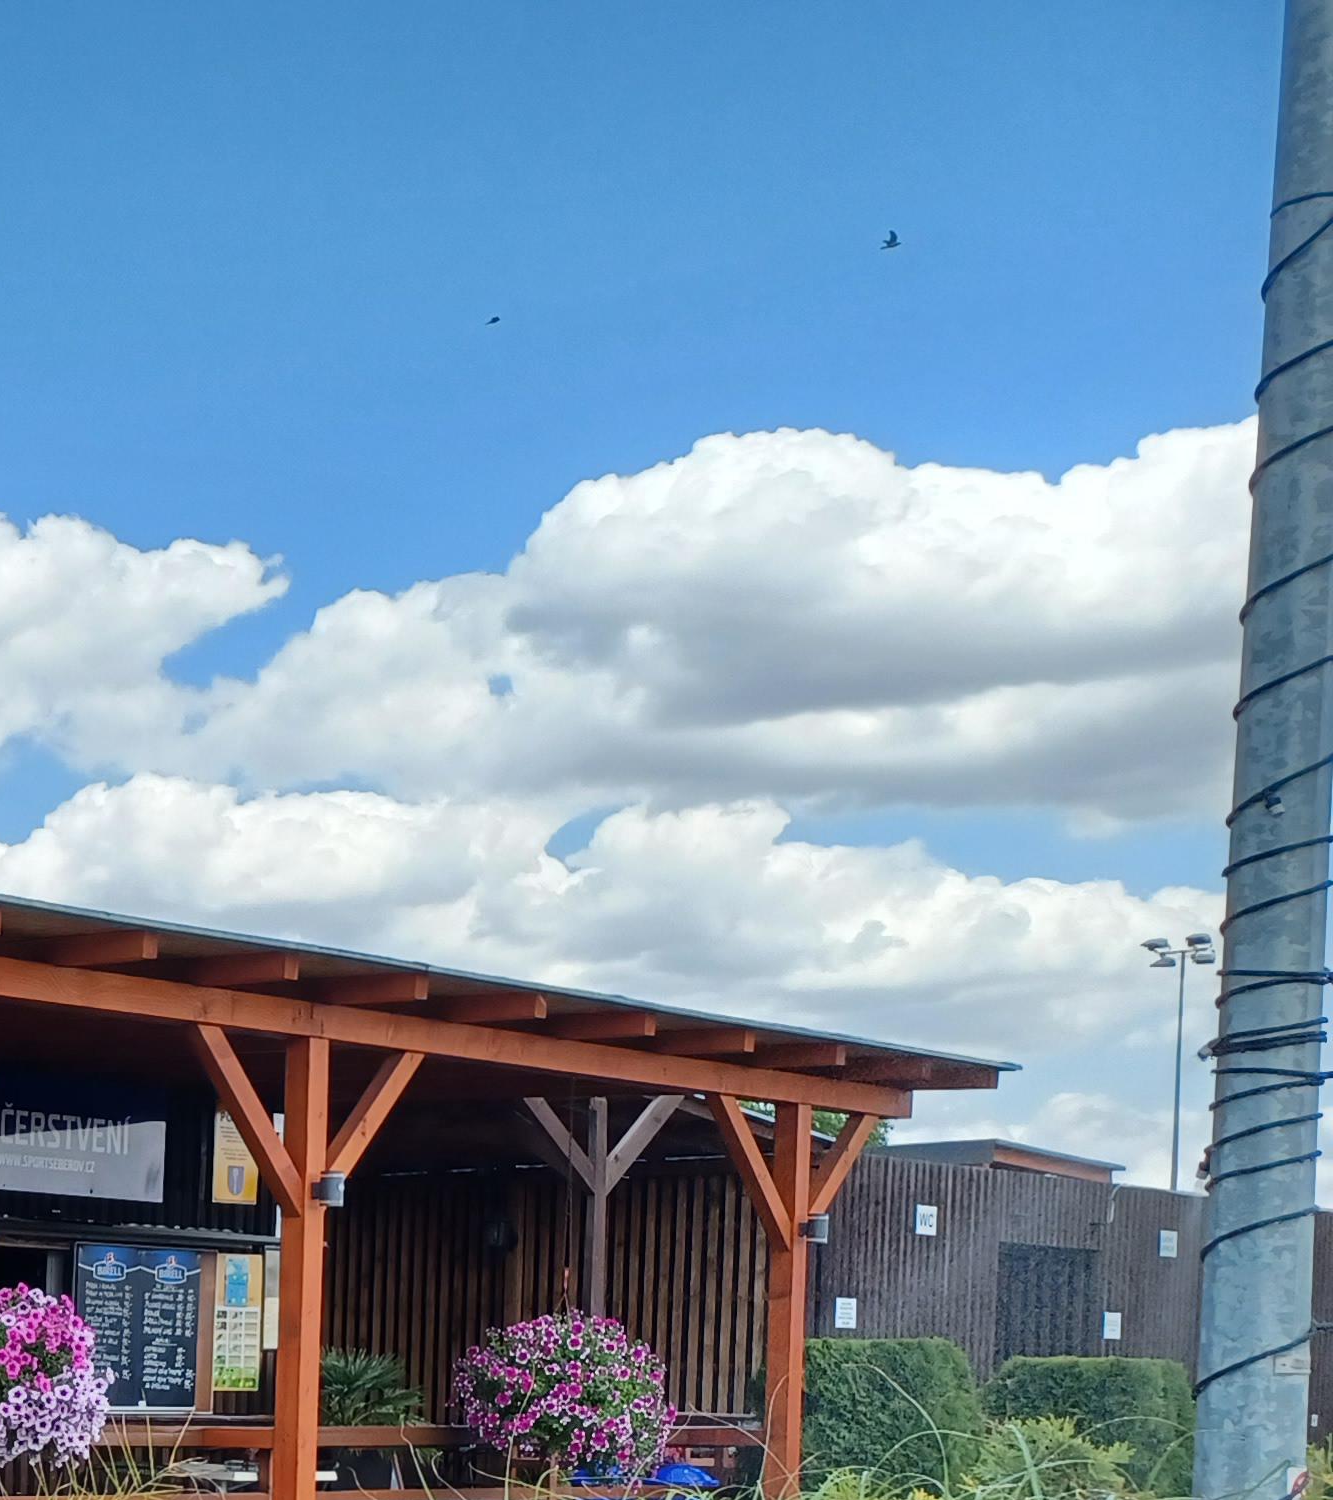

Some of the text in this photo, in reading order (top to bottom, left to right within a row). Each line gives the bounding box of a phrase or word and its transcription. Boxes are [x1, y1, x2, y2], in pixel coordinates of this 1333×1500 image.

[919, 1213, 934, 1228] WC
[97, 1265, 122, 1276] BIRELL
[158, 1269, 183, 1280] BIRELL
